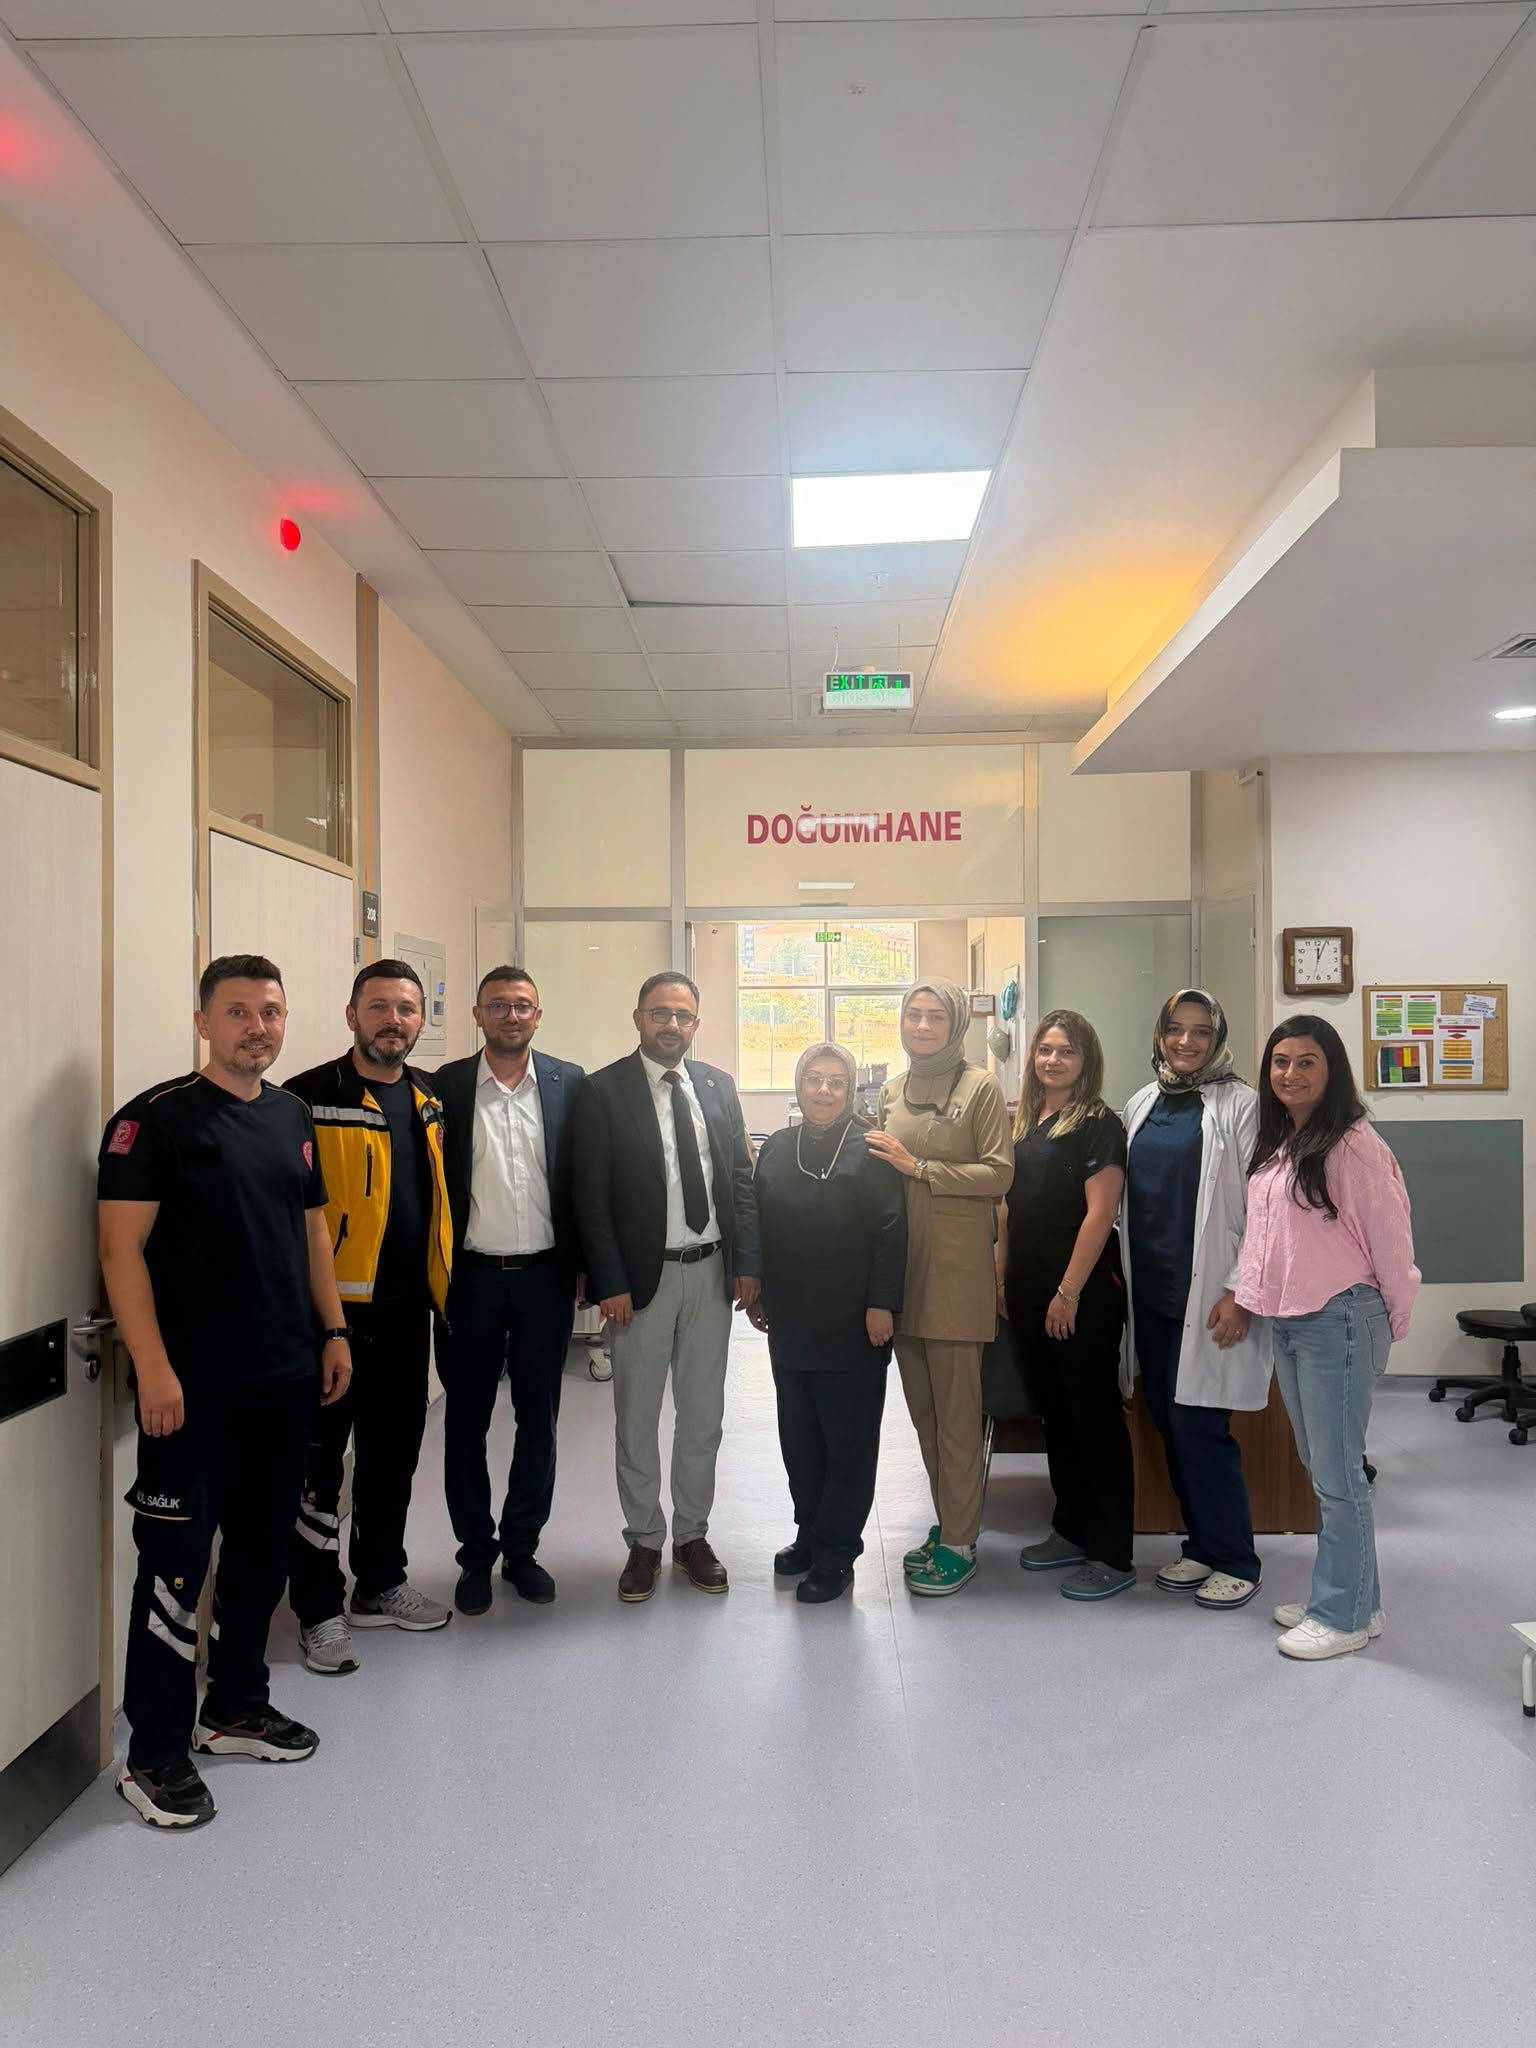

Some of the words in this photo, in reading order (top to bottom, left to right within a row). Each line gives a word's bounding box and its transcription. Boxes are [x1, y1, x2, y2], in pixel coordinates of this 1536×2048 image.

[831, 674, 865, 690] EXIT
[747, 805, 962, 844] DOĞUMHANE
[147, 1494, 180, 1509] SAĞLIK
